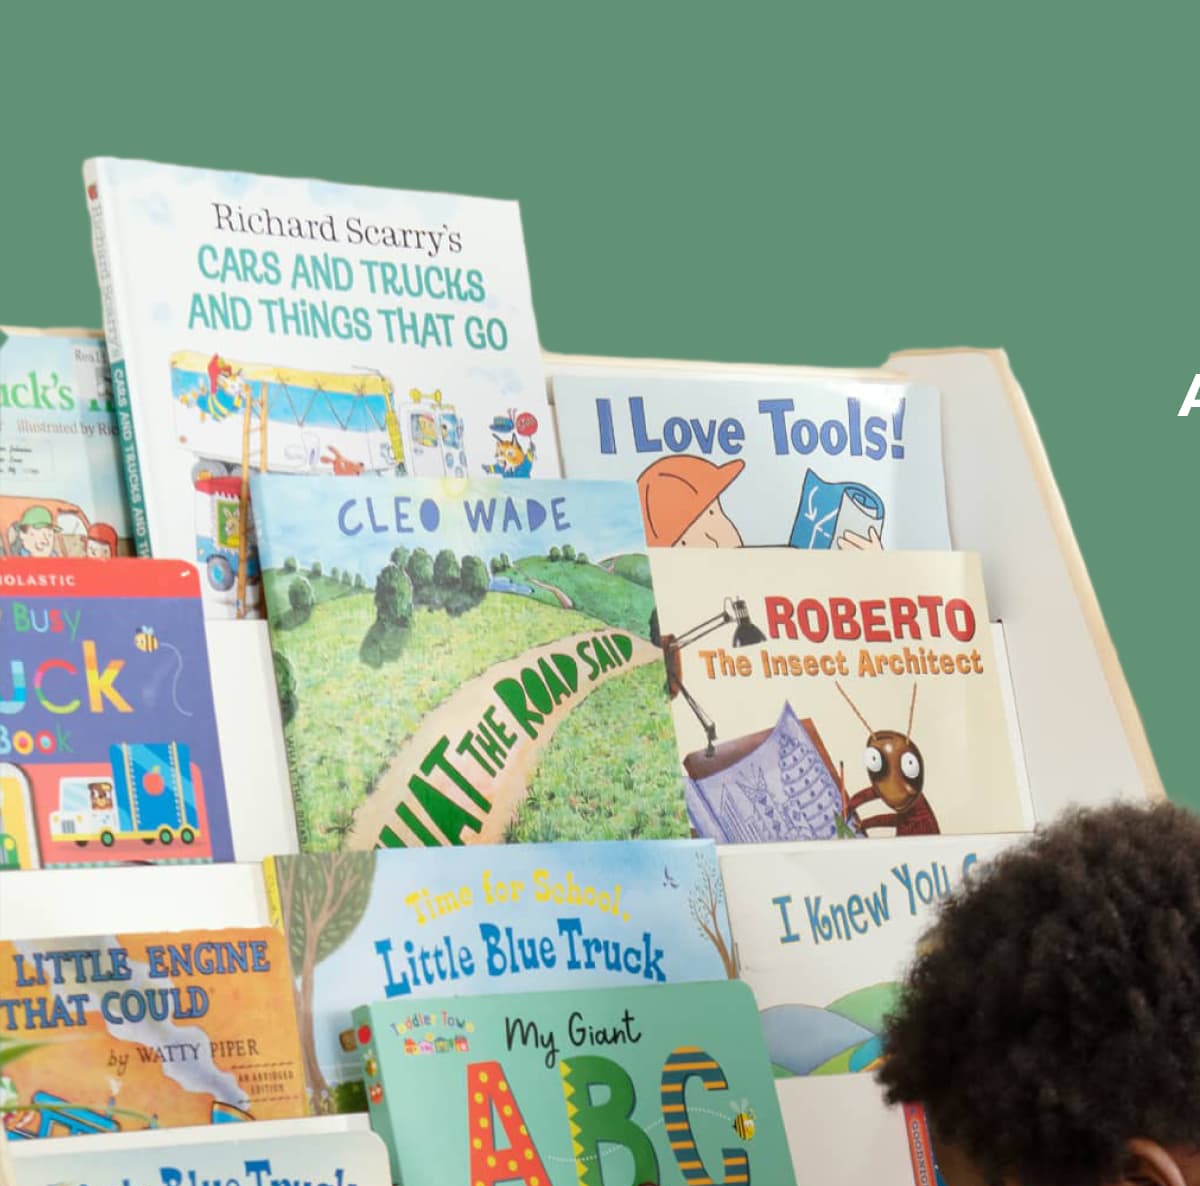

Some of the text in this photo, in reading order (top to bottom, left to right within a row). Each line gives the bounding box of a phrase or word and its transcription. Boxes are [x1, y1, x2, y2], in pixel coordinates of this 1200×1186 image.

[211, 202, 463, 257] Richard Scarry's
[197, 243, 486, 303] CARS AND TRUCKS
[188, 291, 252, 332] AND
[377, 306, 455, 349] THAT
[464, 315, 508, 351] GO
[113, 368, 128, 407] CARS
[119, 410, 132, 441] AND
[595, 396, 906, 460] I Love Tools!
[125, 444, 142, 504] TRUCKS
[133, 506, 147, 537] AND
[337, 496, 571, 536] CLEO WADE
[764, 595, 977, 643] ROBERTO
[699, 648, 984, 680] The Insect Architect
[455, 705, 518, 778] THE
[493, 652, 578, 740] ROAD
[576, 633, 634, 681] SAID
[405, 884, 474, 926] Time
[481, 869, 526, 905] for
[772, 894, 800, 943] I
[804, 883, 891, 944] Knew
[891, 861, 951, 915] You
[13, 940, 271, 987] LITTLE ENGINE
[374, 917, 667, 998] Little Blue Truck
[0, 986, 210, 1030] THAT COULD
[107, 1039, 260, 1076] by WATTY PIPER
[505, 1009, 642, 1068] My Giant
